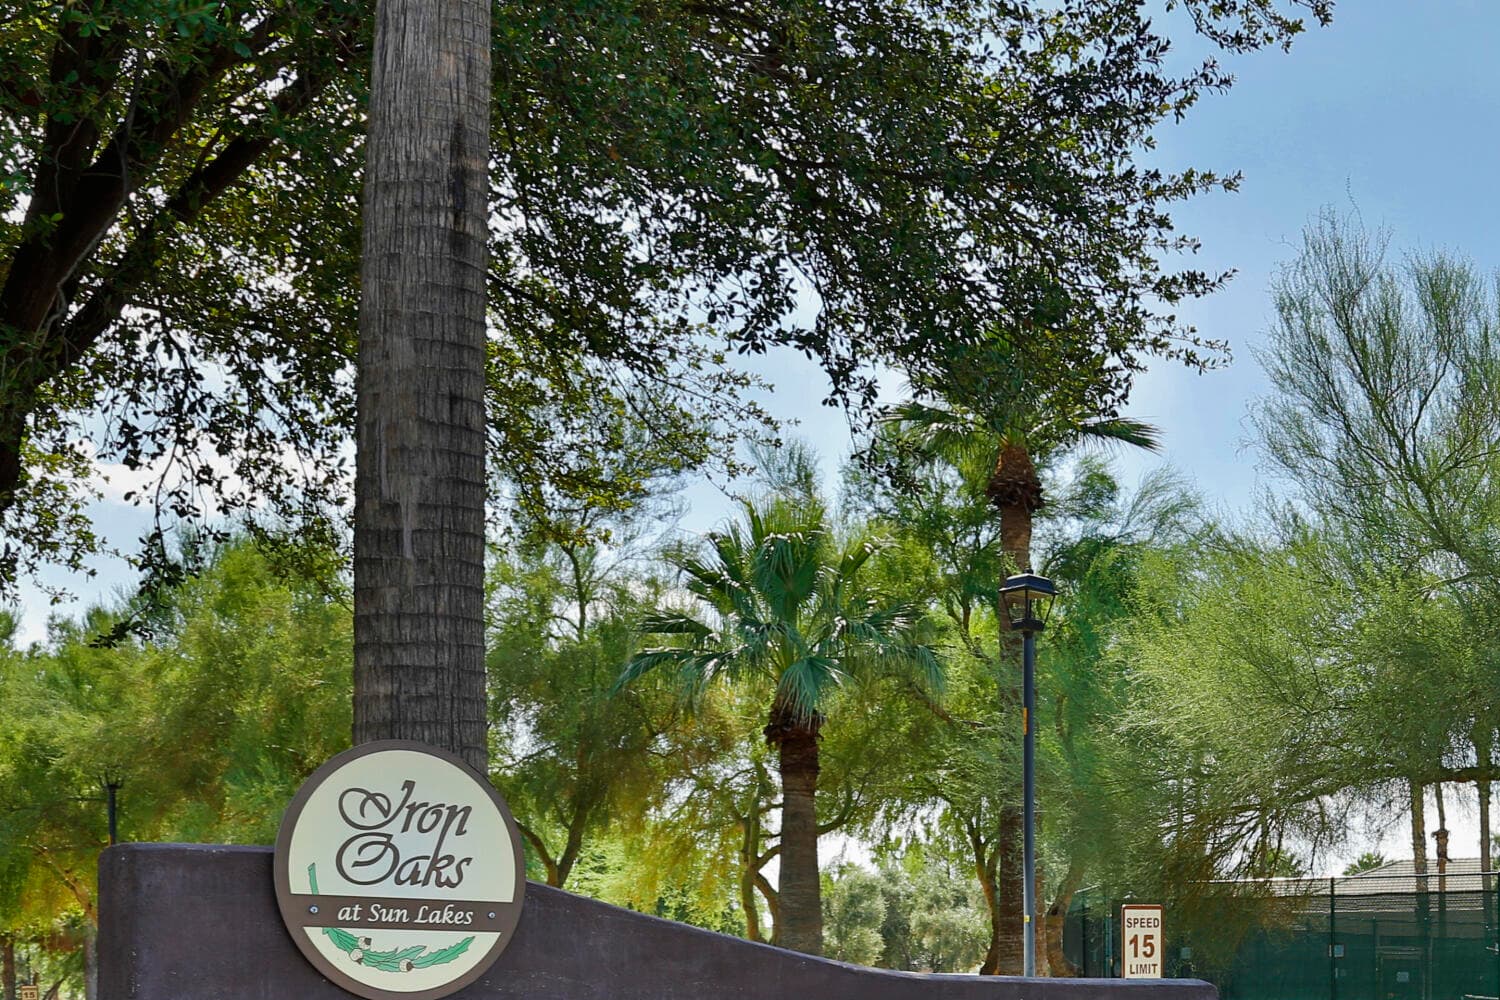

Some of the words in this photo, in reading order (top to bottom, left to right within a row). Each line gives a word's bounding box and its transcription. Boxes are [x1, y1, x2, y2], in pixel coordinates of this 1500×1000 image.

[338, 780, 473, 836] Iron
[335, 831, 473, 889] Oaks
[337, 904, 362, 921] at
[368, 904, 410, 923] Sun
[414, 904, 474, 924] Lakes
[1126, 917, 1160, 928] SPEED
[1129, 934, 1155, 958] 15
[1129, 964, 1158, 974] LIMIT
